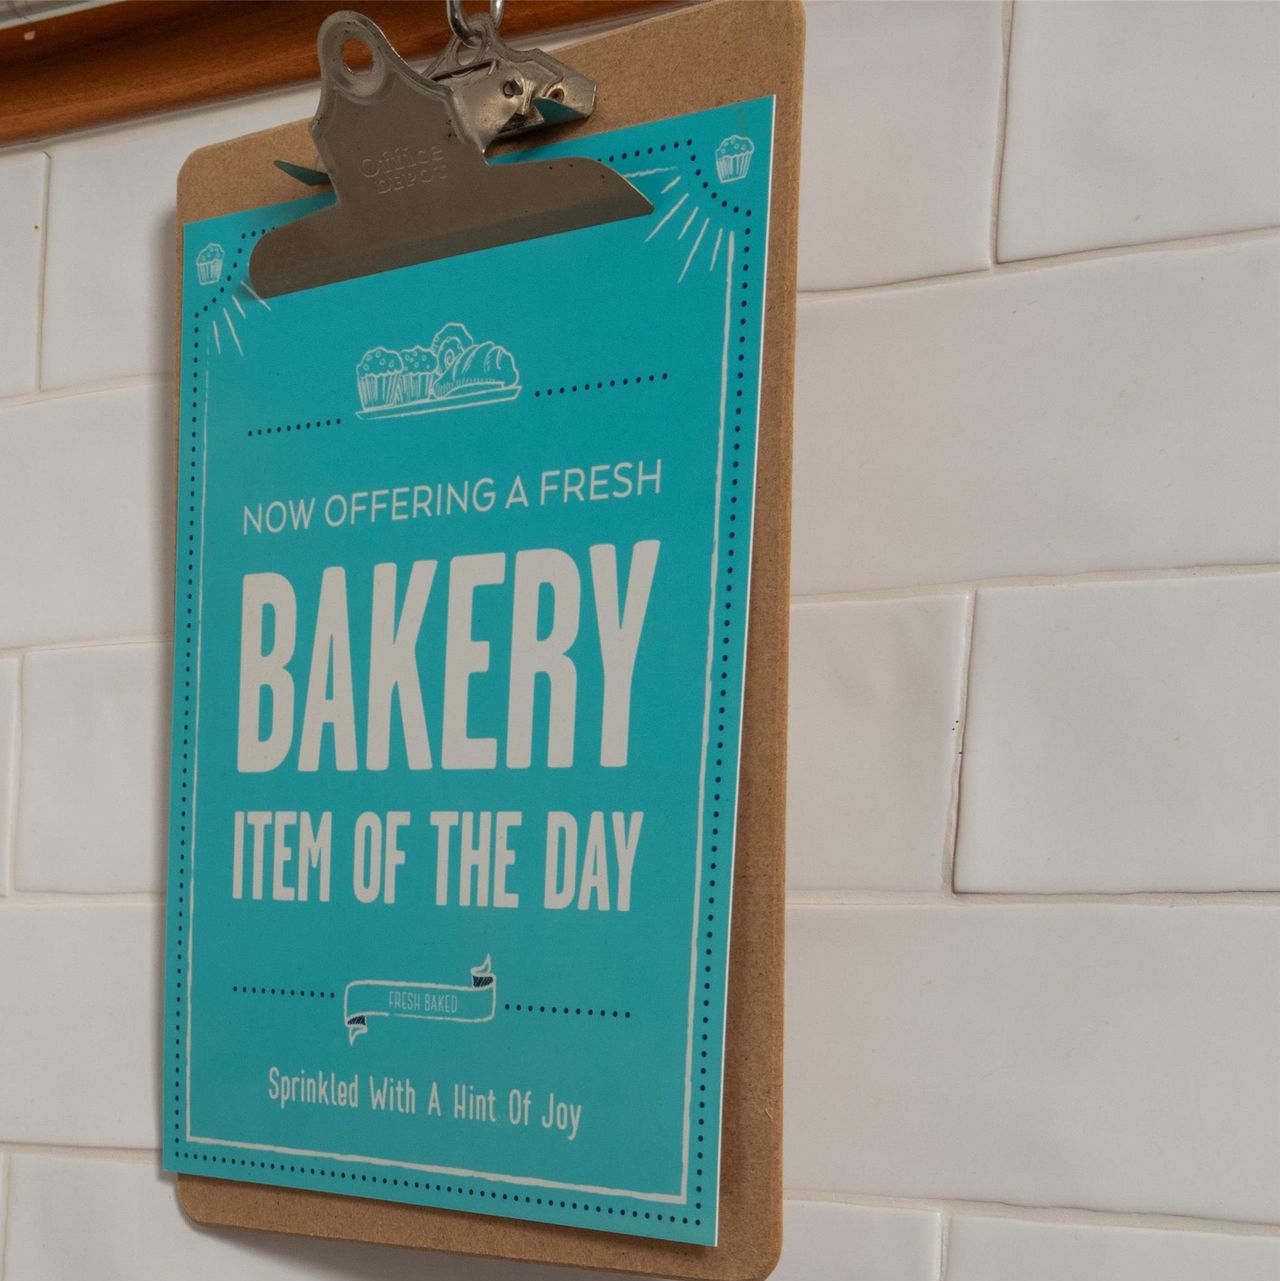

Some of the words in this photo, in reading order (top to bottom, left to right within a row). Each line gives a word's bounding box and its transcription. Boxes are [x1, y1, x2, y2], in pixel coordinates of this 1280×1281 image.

[242, 497, 316, 536] NOW
[324, 477, 497, 528] OFFERING
[505, 475, 529, 509] A
[540, 458, 662, 506] FRESH
[236, 539, 661, 774] BAKERY
[232, 811, 333, 902] ITEM
[352, 811, 411, 904] OF
[430, 811, 523, 908] THE
[543, 811, 645, 912] DAY
[389, 990, 421, 1011] FRESH
[424, 992, 458, 1014] BAKED
[268, 1066, 359, 1109] Sprinkled
[369, 1075, 416, 1115] With
[428, 1081, 441, 1117] A
[453, 1084, 497, 1123] Hint
[508, 1089, 532, 1127] Of
[542, 1093, 582, 1141] Joy
